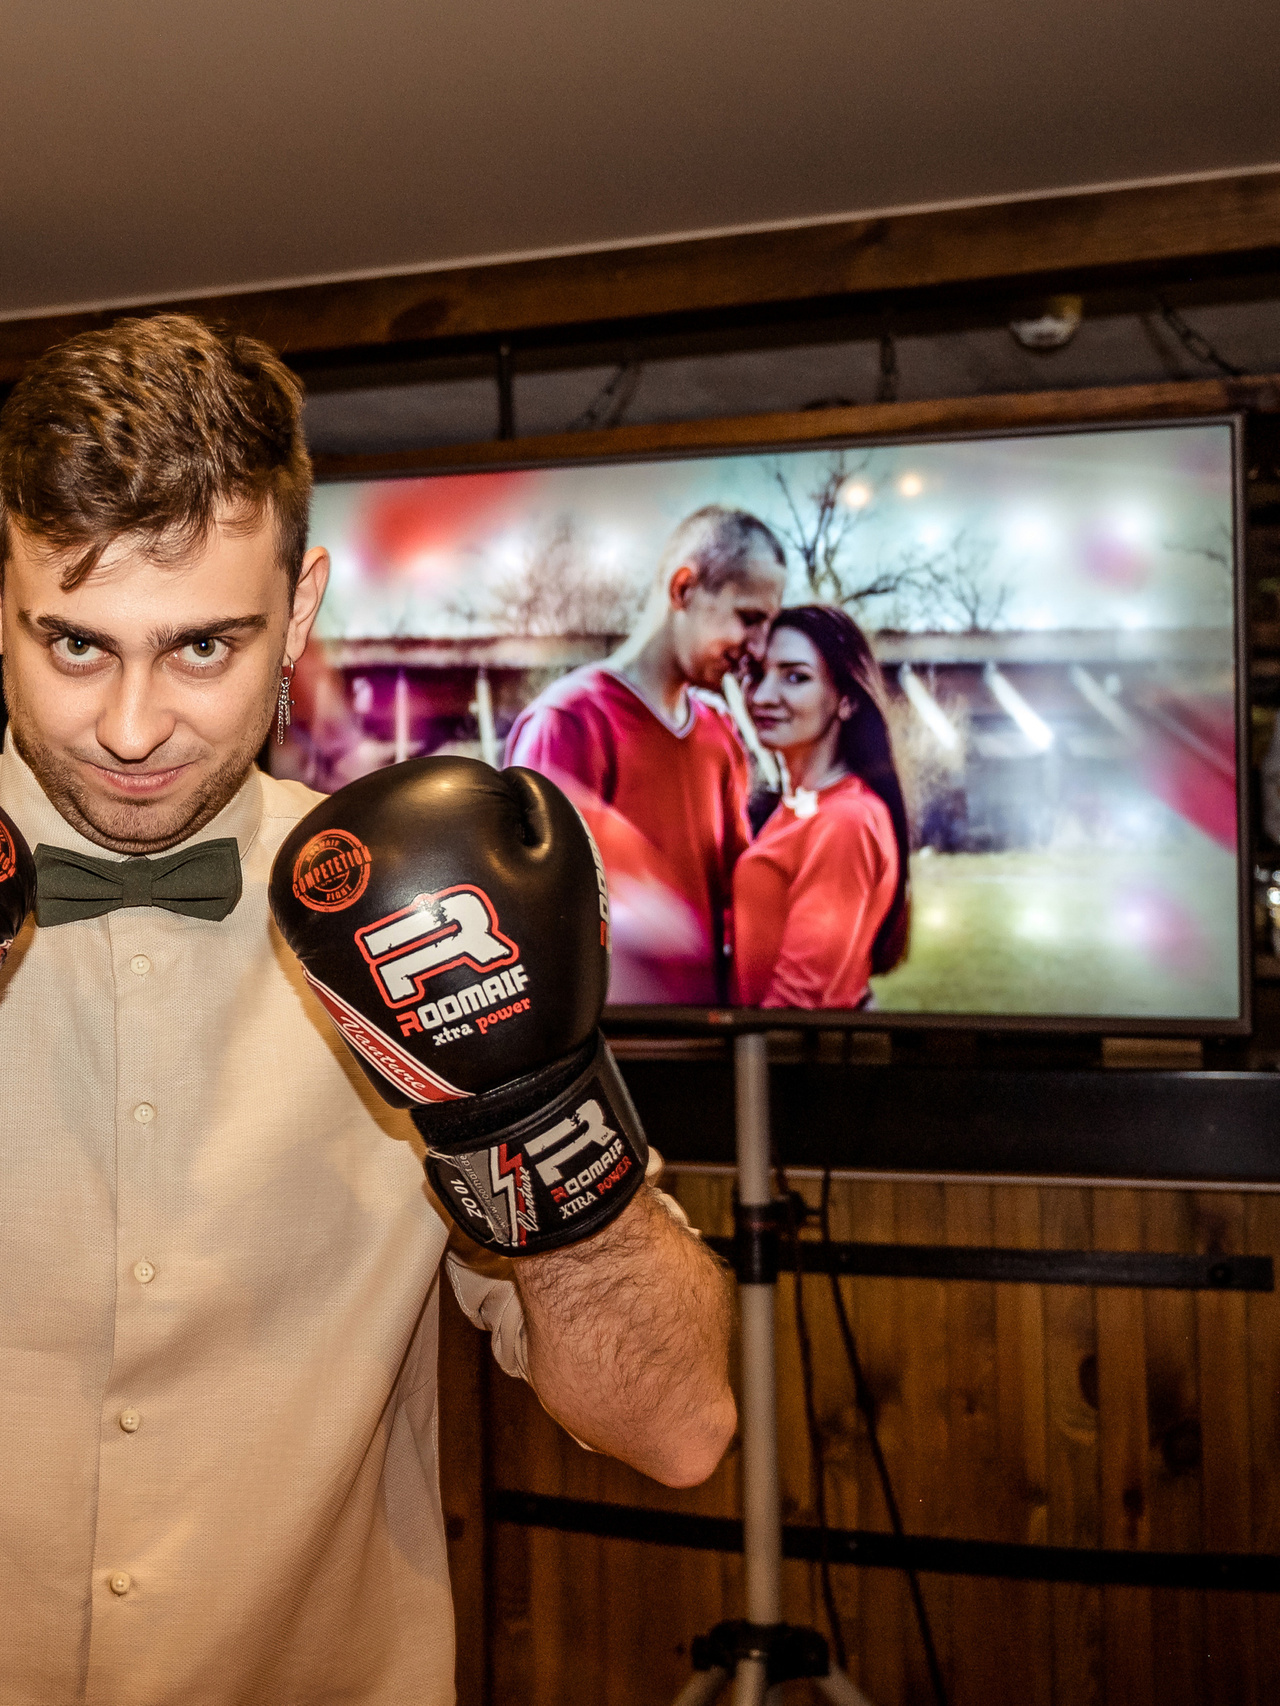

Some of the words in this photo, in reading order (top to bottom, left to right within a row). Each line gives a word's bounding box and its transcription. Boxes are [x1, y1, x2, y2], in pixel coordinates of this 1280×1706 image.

[396, 964, 531, 1037] ROOMAIF
[432, 1023, 474, 1047] xtra
[475, 996, 531, 1034] power
[450, 1178, 469, 1195] 10
[461, 1197, 484, 1218] OZ
[550, 1138, 623, 1203] ROOMAIF
[559, 1191, 598, 1220] XTRA
[596, 1155, 632, 1196] POWER
